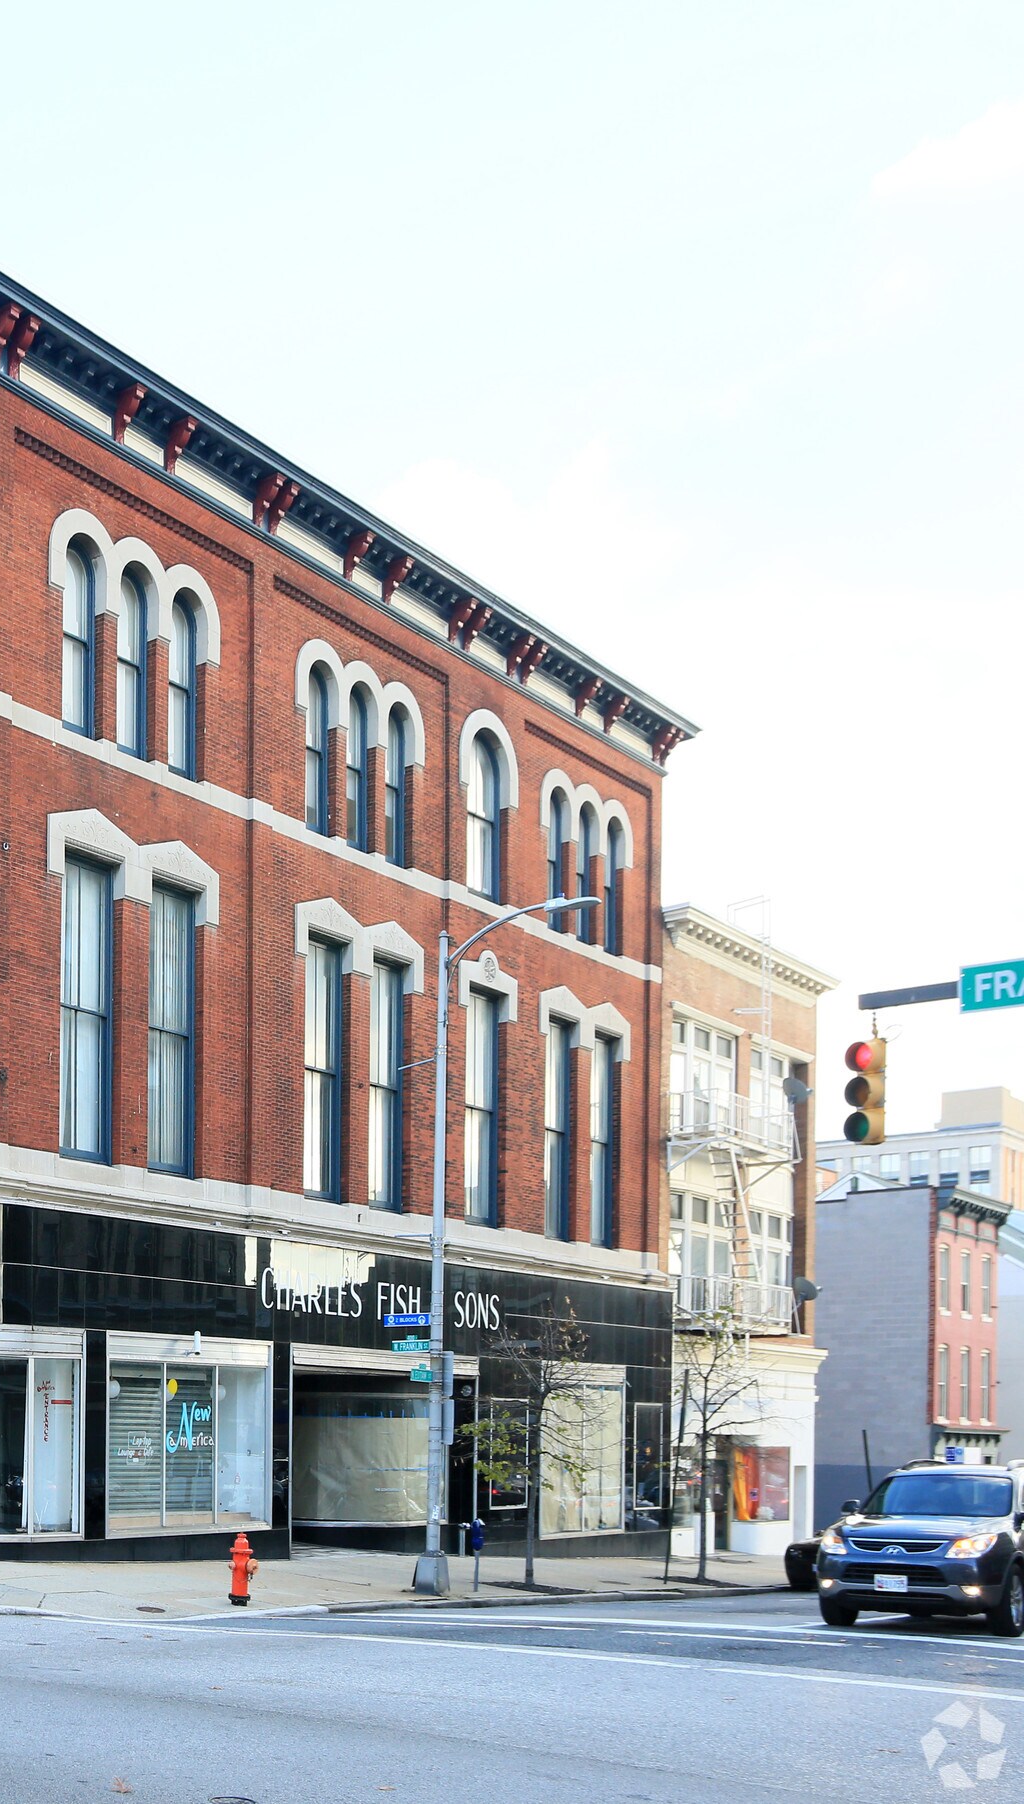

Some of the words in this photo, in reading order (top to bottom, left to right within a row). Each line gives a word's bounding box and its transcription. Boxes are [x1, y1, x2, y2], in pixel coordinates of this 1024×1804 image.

[261, 1267, 363, 1318] CHARLES
[377, 1281, 421, 1321] FISH
[454, 1290, 500, 1331] SONS
[399, 1341, 423, 1351] FRANKLIN
[166, 1401, 212, 1453] New
